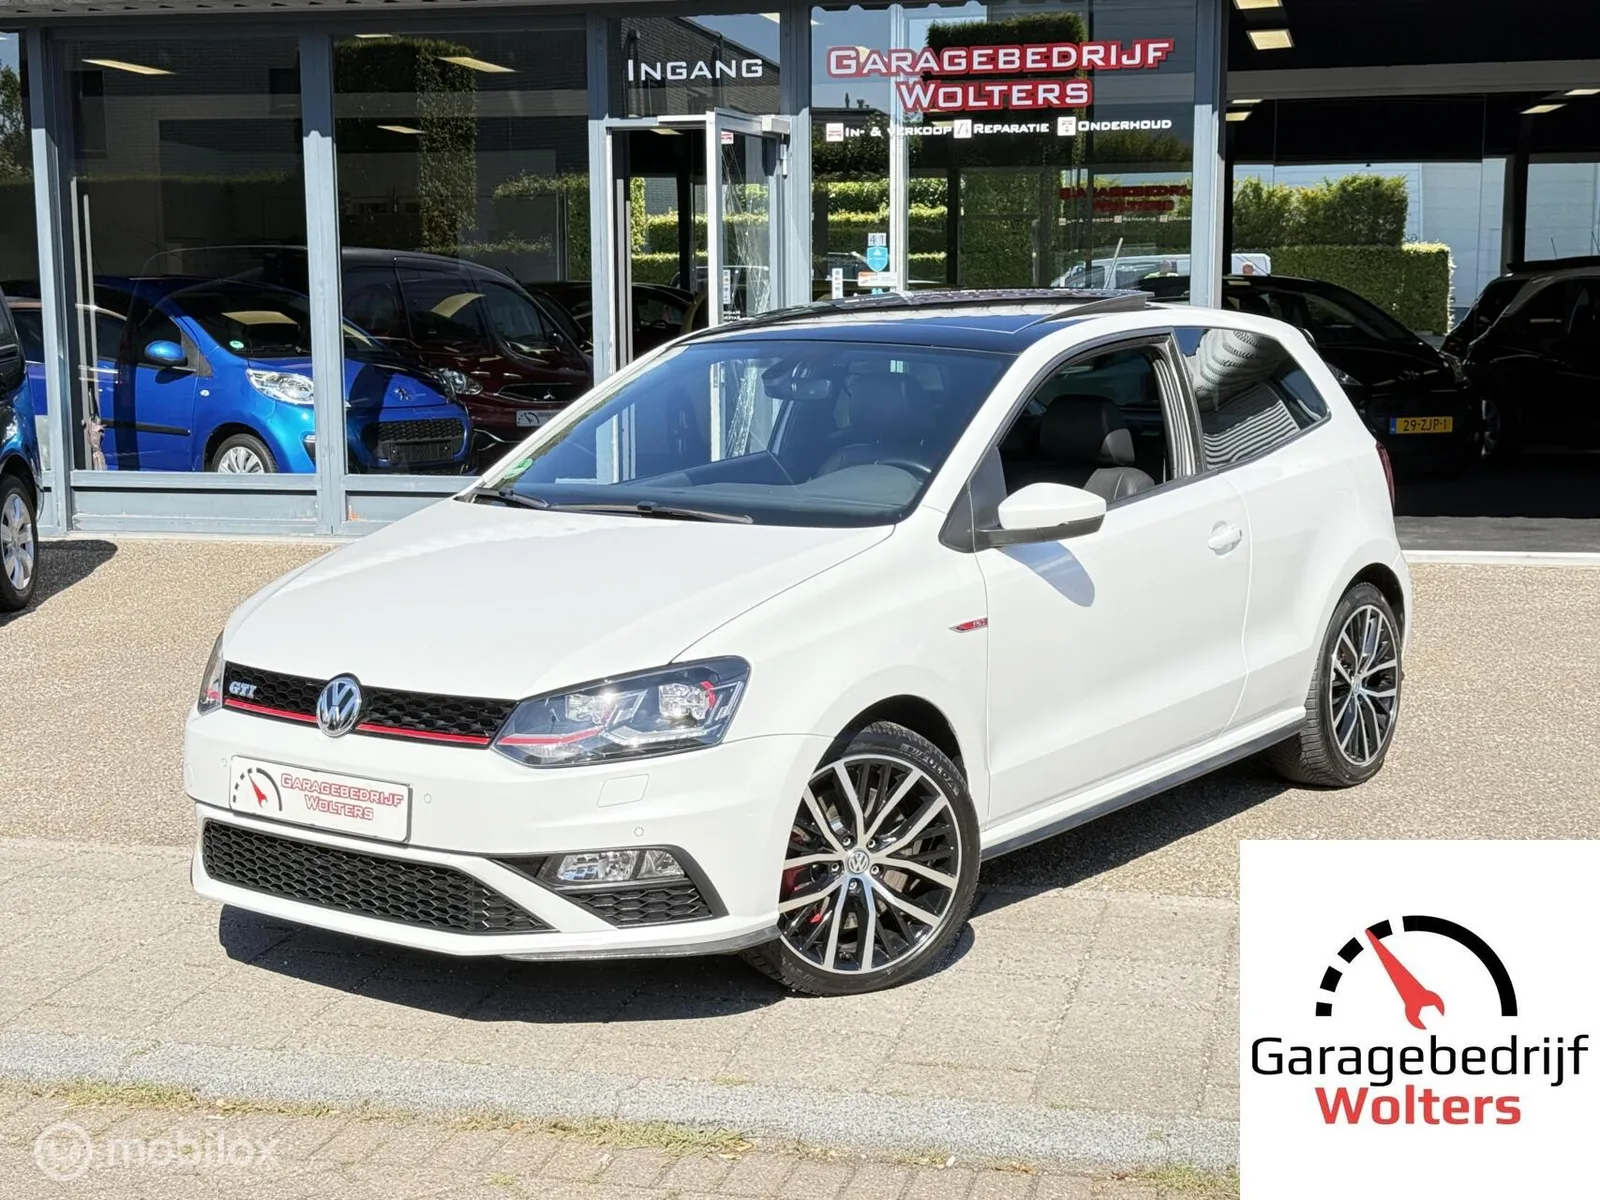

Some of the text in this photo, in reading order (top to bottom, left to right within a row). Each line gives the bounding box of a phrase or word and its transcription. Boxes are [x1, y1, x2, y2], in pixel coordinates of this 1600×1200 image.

[628, 57, 763, 81] INGANG
[827, 39, 1175, 77] GARAGEBEDRIJF
[896, 79, 1093, 112] WOLTERS
[870, 126, 884, 138] &
[974, 123, 1049, 134] REPARATIE
[1078, 119, 1172, 131] ONDERHOUD
[1403, 418, 1447, 432] 29-ZJP-1
[229, 680, 257, 699] GTI
[281, 773, 404, 807] GARAGEBEDRIJF
[305, 794, 374, 820] WOLTERS
